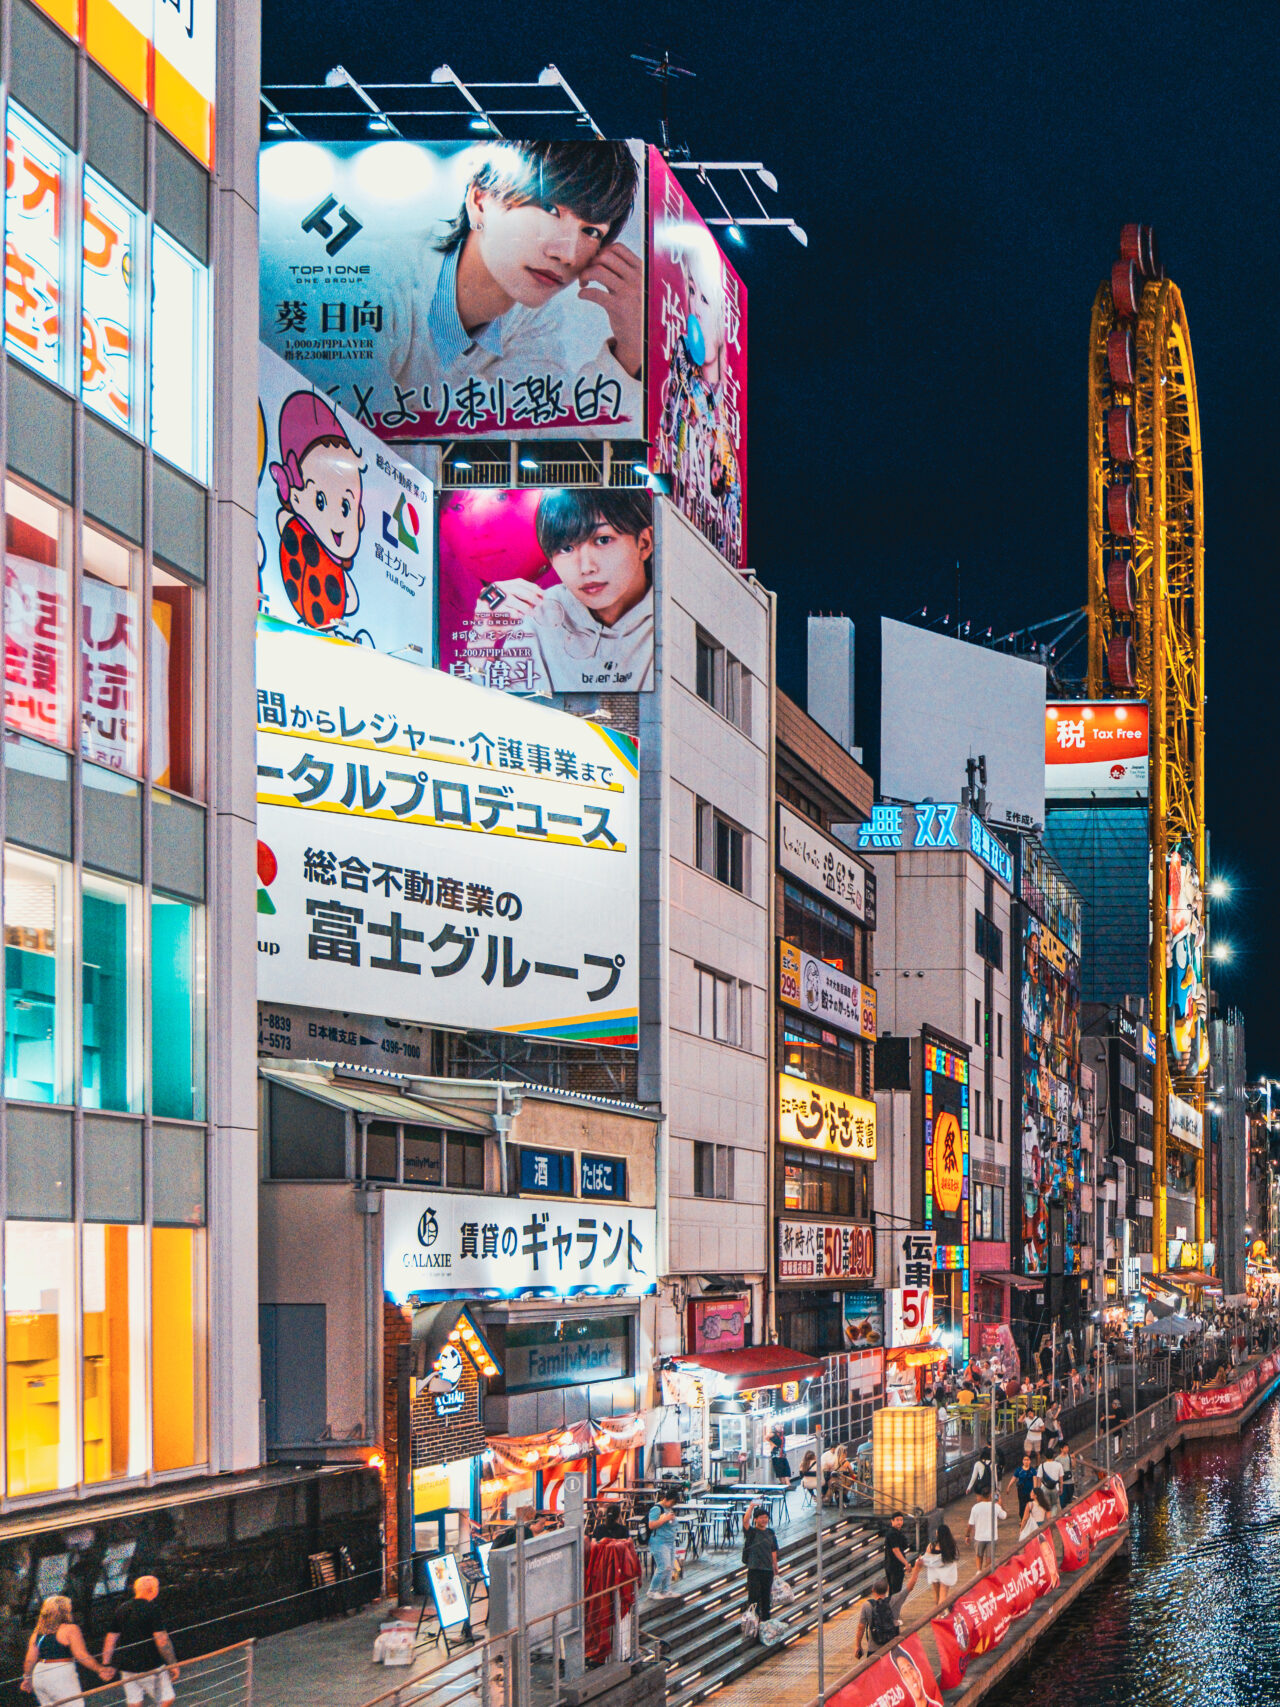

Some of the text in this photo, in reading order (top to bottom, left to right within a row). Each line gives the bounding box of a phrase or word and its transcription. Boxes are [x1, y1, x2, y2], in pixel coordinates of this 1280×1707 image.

[275, 301, 383, 334] 葵 日向
[376, 453, 428, 504] 総合不動産業の
[374, 543, 427, 588] 富士グループ
[386, 571, 416, 597] FUJI Group
[1057, 719, 1085, 749] 税
[1092, 728, 1143, 739] Tax Free
[858, 804, 960, 848] 無双
[303, 847, 523, 921] 総合不動産業の
[305, 898, 626, 1002] 富士グループ
[782, 973, 797, 998] 299
[308, 1023, 358, 1046] 日本橋支店
[863, 1009, 873, 1032] 99
[381, 1038, 421, 1059] 4396-7000
[796, 1090, 853, 1148] うなぎ
[534, 1156, 549, 1187] 酒
[582, 1162, 613, 1192] たばこ
[460, 1212, 647, 1275] 賃貸のギャラント
[783, 1225, 815, 1257] 新時代
[816, 1227, 824, 1276] 伝串
[824, 1227, 842, 1276] 50
[850, 1227, 874, 1276] 190
[403, 1254, 451, 1269] GALAXIE
[903, 1235, 933, 1288] 伝串
[529, 1344, 611, 1377] FamilyMart
